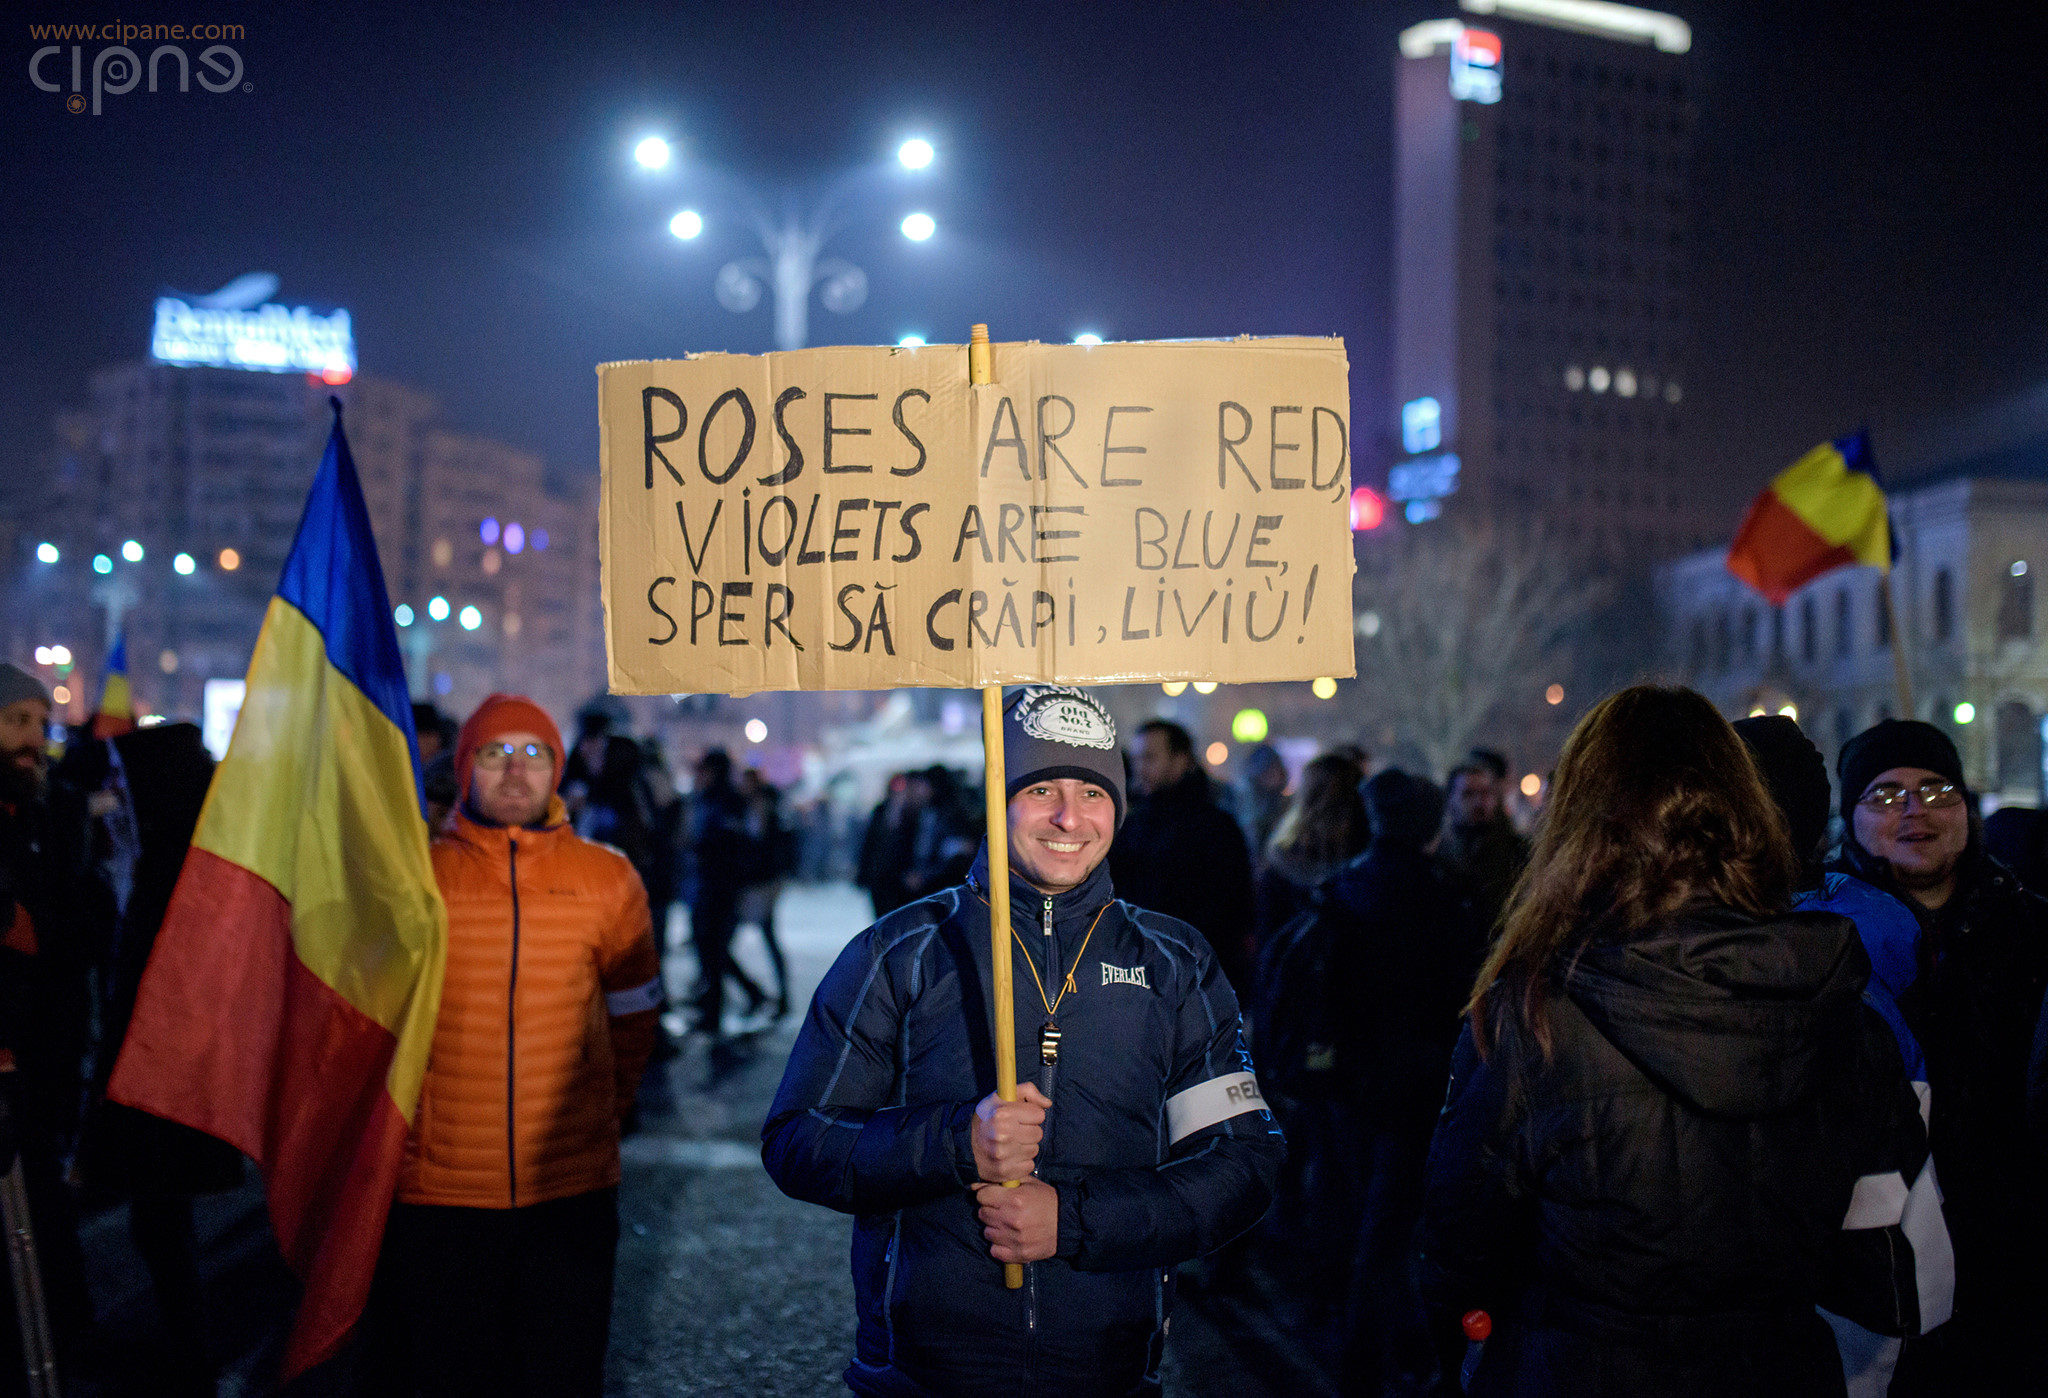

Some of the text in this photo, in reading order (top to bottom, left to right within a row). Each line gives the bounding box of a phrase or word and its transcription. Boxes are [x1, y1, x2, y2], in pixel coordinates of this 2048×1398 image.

[642, 386, 931, 489] ROSES
[980, 395, 1154, 489] ARE
[1218, 401, 1347, 503] RED,
[676, 487, 1289, 576] VIOLETS ARE BLUE,
[648, 576, 804, 651] SPER
[828, 581, 898, 655] SĂ
[1101, 962, 1150, 989] EVERLAST
